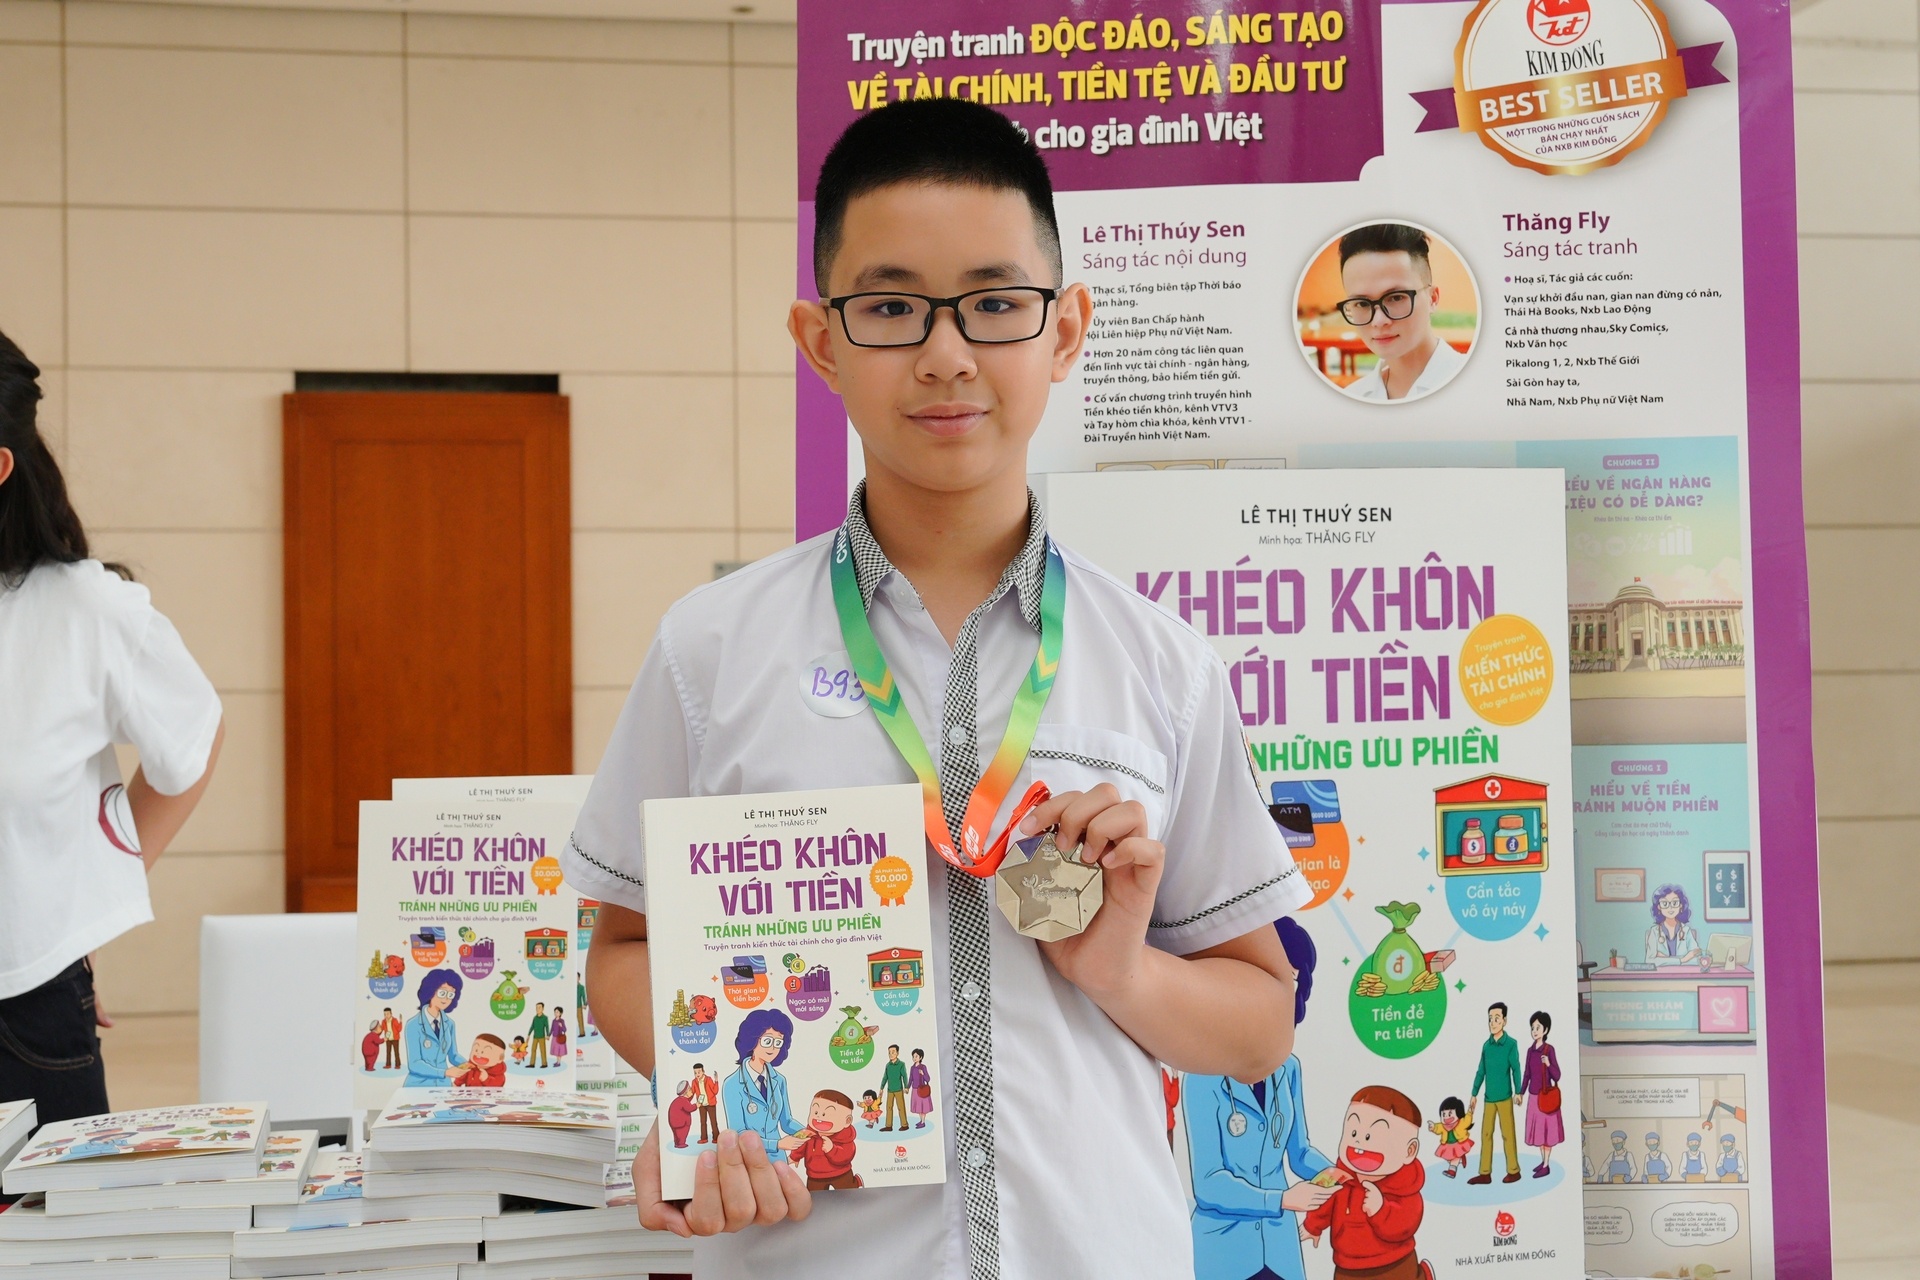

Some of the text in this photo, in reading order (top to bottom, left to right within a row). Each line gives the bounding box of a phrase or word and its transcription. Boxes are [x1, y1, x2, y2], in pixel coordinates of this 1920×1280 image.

[847, 10, 1344, 66] Truyện tranh ĐỘC ĐÁO, SÁNG TẠO
[847, 71, 887, 110] VỀ
[949, 69, 1052, 106] CHÍNH,
[1058, 62, 1131, 102] TIỀN
[1134, 65, 1173, 104] TỆ
[1177, 60, 1217, 98] VÀ
[1228, 54, 1297, 94] ĐẦU
[1302, 55, 1348, 92] TƯ
[1479, 72, 1664, 123] BEST SELLER
[1035, 112, 1263, 154] cho gia đình Việt
[1084, 221, 1244, 246] Lê Thị Thúy Sen
[1503, 211, 1610, 234] Thăng Fly
[1083, 248, 1246, 271] Sáng tác nội dung
[1504, 238, 1637, 261] Sáng tác tranh
[1565, 474, 1590, 491] IỂU
[1242, 503, 1391, 527] LÊ THỊ THUÝ SEN
[1259, 529, 1375, 546] Minh họa: THĂNG FLY
[1330, 552, 1496, 633] KHÔN
[1464, 644, 1544, 679] KIẾN THỨC
[1224, 639, 1450, 726] ỚI TIỀN
[1469, 665, 1547, 697] TÀI CHÍNH
[1250, 726, 1498, 772] NHỮNG ƯU PHIỀN
[1280, 806, 1301, 814] ATM
[393, 832, 546, 862] KHÉO KHÔN
[690, 827, 886, 875] KHÉO KHÔN
[413, 865, 524, 895] VỚI TIỀN
[874, 873, 908, 883] 30.000
[1465, 882, 1520, 899] Cẩn tắc
[719, 872, 863, 916] VỚI TIỀN
[1462, 903, 1526, 920] vô áy náy
[704, 913, 881, 938] TRÁNH NHỮNG ƯU PHIỀN
[1372, 1004, 1424, 1022] Tiền đẻ
[1374, 1025, 1422, 1041] ra tiền
